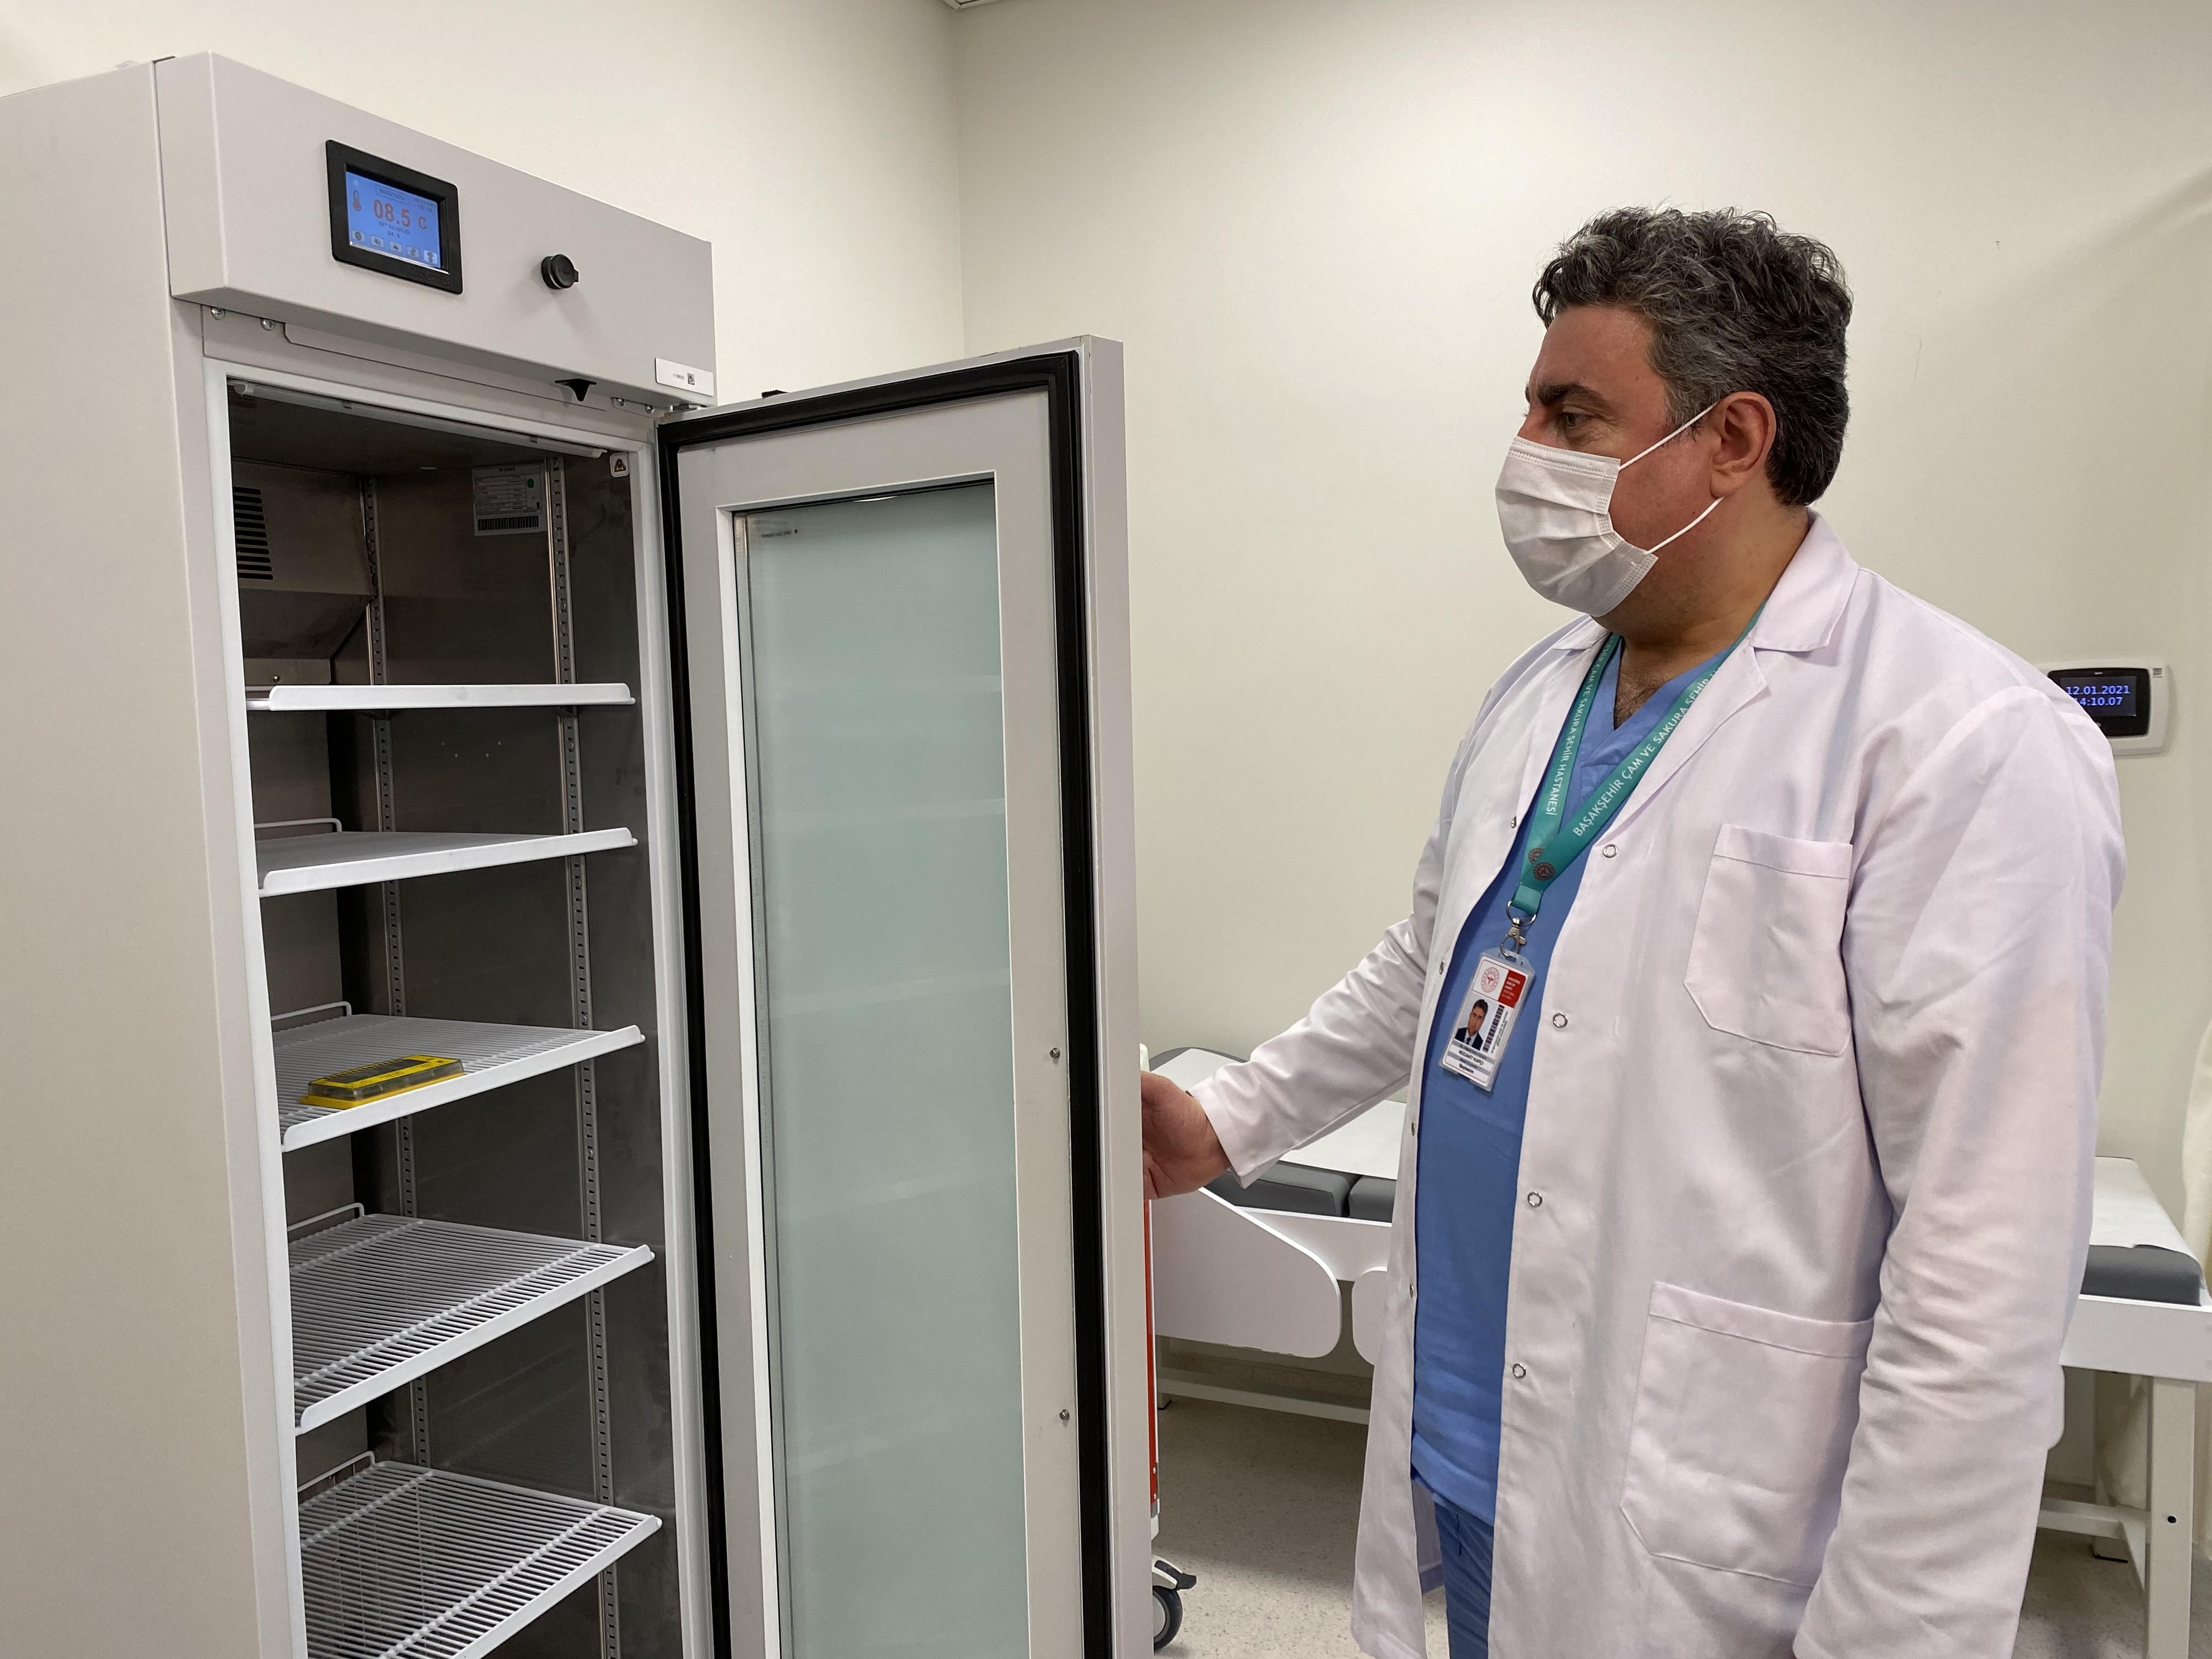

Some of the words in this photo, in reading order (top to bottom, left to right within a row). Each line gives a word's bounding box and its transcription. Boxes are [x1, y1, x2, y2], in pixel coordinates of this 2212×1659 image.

[374, 200, 410, 227] 08.5
[418, 217, 427, 230] C
[1583, 684, 1593, 697] VE
[2067, 686, 2130, 695] 12.01.2021
[1568, 698, 1587, 736] SAKURA
[1561, 735, 1576, 761] ŞEHİR
[1573, 778, 1624, 837] BAŞAKŞEHİR
[1621, 758, 1644, 780] ÇAM
[1640, 743, 1656, 759] VE
[1653, 707, 1689, 744] SAKURA
[1545, 763, 1567, 816] HASTANESİ
